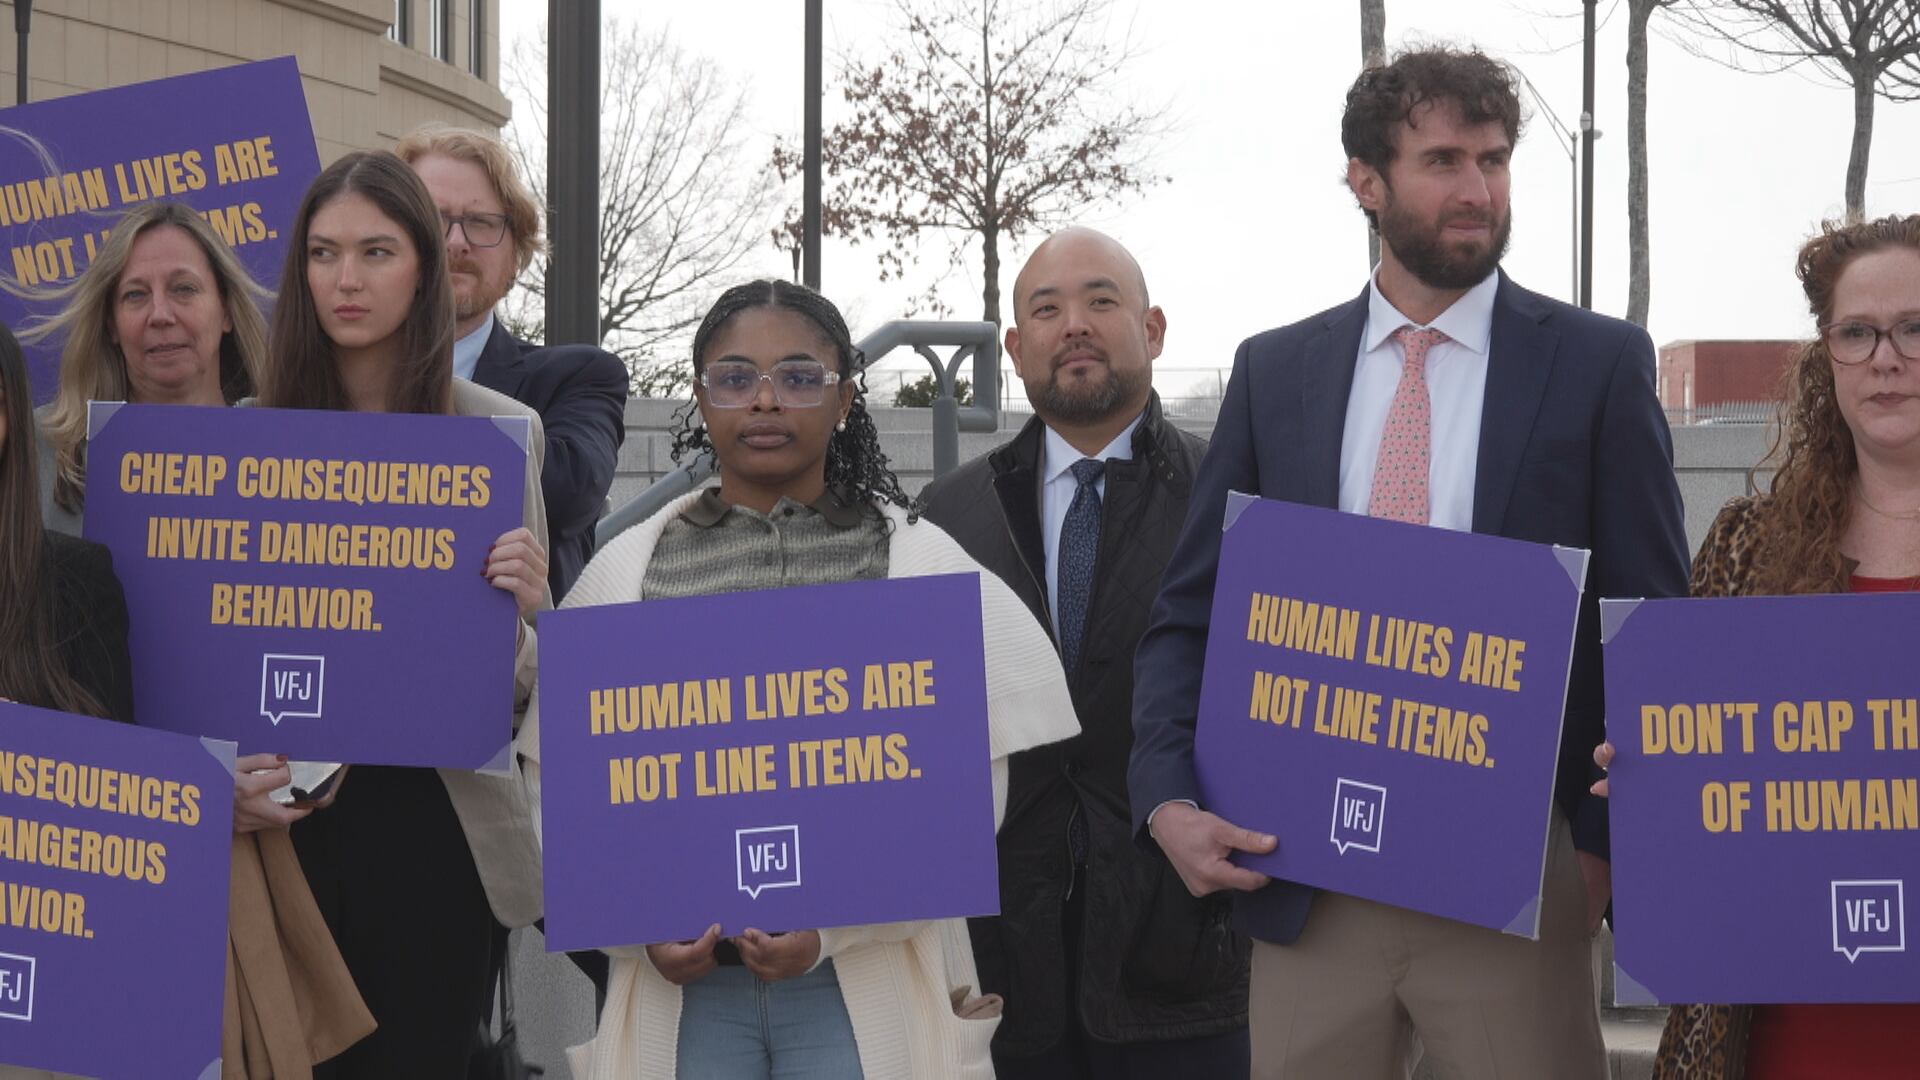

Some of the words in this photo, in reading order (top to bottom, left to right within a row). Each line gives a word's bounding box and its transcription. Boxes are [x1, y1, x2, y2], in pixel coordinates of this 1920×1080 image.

[115, 150, 206, 203] LIVES
[215, 136, 278, 185] ARE
[12, 238, 76, 287] NOT
[121, 452, 227, 496] CHEAP
[237, 457, 491, 507] CONSEQUENCES
[148, 517, 249, 561] INVITE
[260, 522, 455, 570] DANGEROUS
[212, 584, 382, 631] BEHAVIOR.
[1247, 593, 1360, 660] HUMAN
[1366, 615, 1453, 678] LIVES
[1459, 632, 1525, 691] ARE
[275, 671, 311, 700] VFJ
[590, 679, 731, 735] HUMAN
[745, 668, 849, 720] LIVES
[863, 660, 935, 710] ARE
[1250, 672, 1309, 728] NOT
[1314, 684, 1382, 744] LINE
[1388, 699, 1494, 768] ITEMS.
[1641, 703, 1758, 754] DON'T
[1773, 701, 1853, 752] CAP
[1867, 699, 1918, 750] TH
[0, 752, 200, 825] NSEQUENCES
[610, 753, 681, 804] NOT
[695, 745, 776, 796] LINE
[789, 733, 921, 788] ITEMS.
[1344, 798, 1374, 832] VFJ
[1702, 782, 1750, 832] OF
[1765, 779, 1918, 832] HUMAN
[0, 816, 166, 884] ANGEROUS
[748, 842, 787, 872] VFJ
[1846, 900, 1889, 931] VFJ
